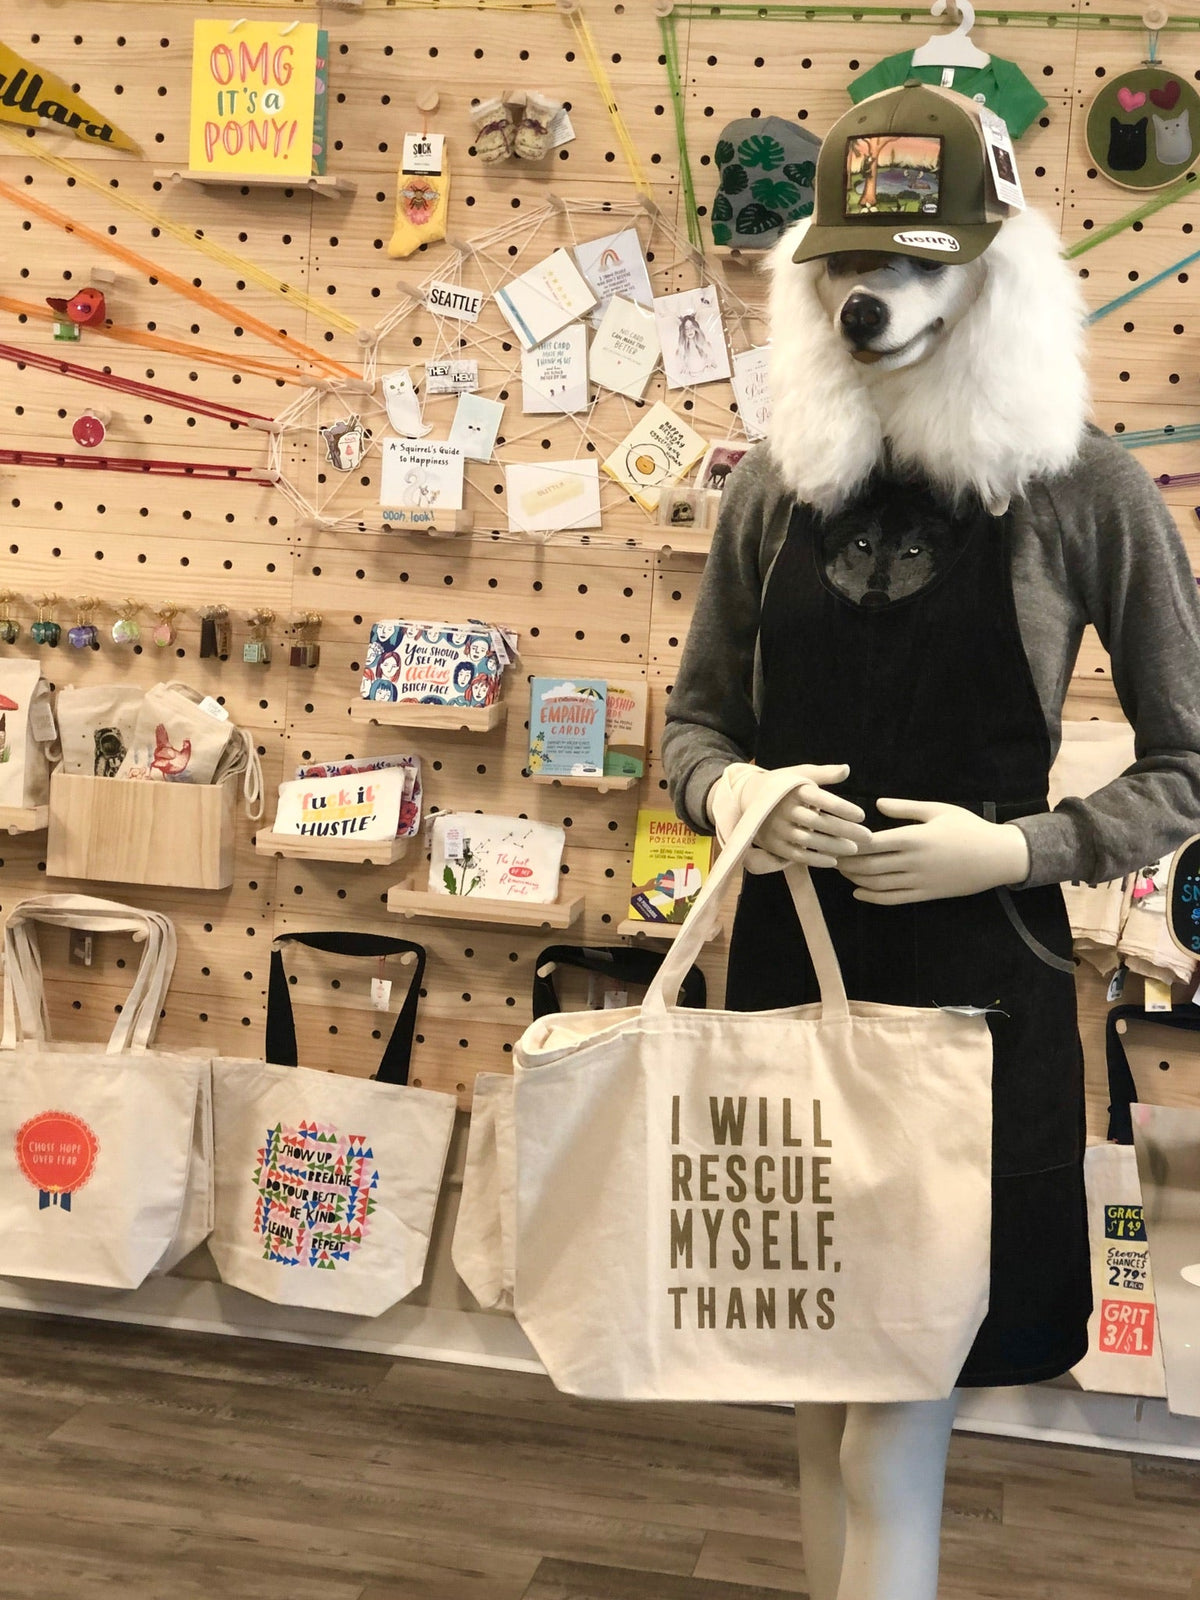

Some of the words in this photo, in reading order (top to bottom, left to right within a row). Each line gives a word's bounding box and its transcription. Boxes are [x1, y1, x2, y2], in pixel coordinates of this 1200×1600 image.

[210, 41, 294, 86] OMG
[204, 118, 298, 162] PONY!
[413, 143, 432, 155] SOCK
[898, 234, 958, 250] henry
[430, 288, 480, 314] SEATTLE
[428, 366, 450, 376] THEY
[390, 443, 396, 451] A
[400, 443, 437, 454] Squirrel's
[439, 446, 460, 455] Guide
[410, 456, 449, 467] Happiness
[431, 646, 460, 661] SHOULD
[416, 656, 431, 665] SEE
[433, 657, 447, 668] MY
[401, 682, 426, 694] BITCH
[429, 684, 450, 695] FACE
[540, 705, 600, 725] EMPATHY
[551, 726, 587, 736] CARDS
[357, 786, 376, 804] it
[649, 821, 697, 837] EMPATH
[649, 836, 697, 845] POSTCARDS
[671, 1095, 680, 1145] I
[709, 1096, 833, 1148] WILL
[29, 1141, 55, 1153] CHOSE
[60, 1143, 81, 1155] HOPE
[280, 1144, 316, 1162] SHOW
[317, 1152, 332, 1164] UP
[33, 1155, 54, 1164] OVER
[57, 1156, 77, 1166] FEAR
[308, 1171, 353, 1187] BREATHE
[671, 1154, 833, 1204] RESCUE
[266, 1178, 281, 1191] DO
[282, 1183, 309, 1200] YOUR
[312, 1190, 337, 1204] BEST
[290, 1206, 301, 1220] BE
[306, 1209, 336, 1223] KIND
[267, 1221, 294, 1240] LEARN
[312, 1238, 346, 1251] REPEAT
[1107, 1247, 1149, 1259] Second
[1106, 1258, 1147, 1269] CHANCES
[1123, 1281, 1144, 1290] EACH
[667, 1286, 836, 1331] THANKS
[1104, 1303, 1150, 1325] GRIT
